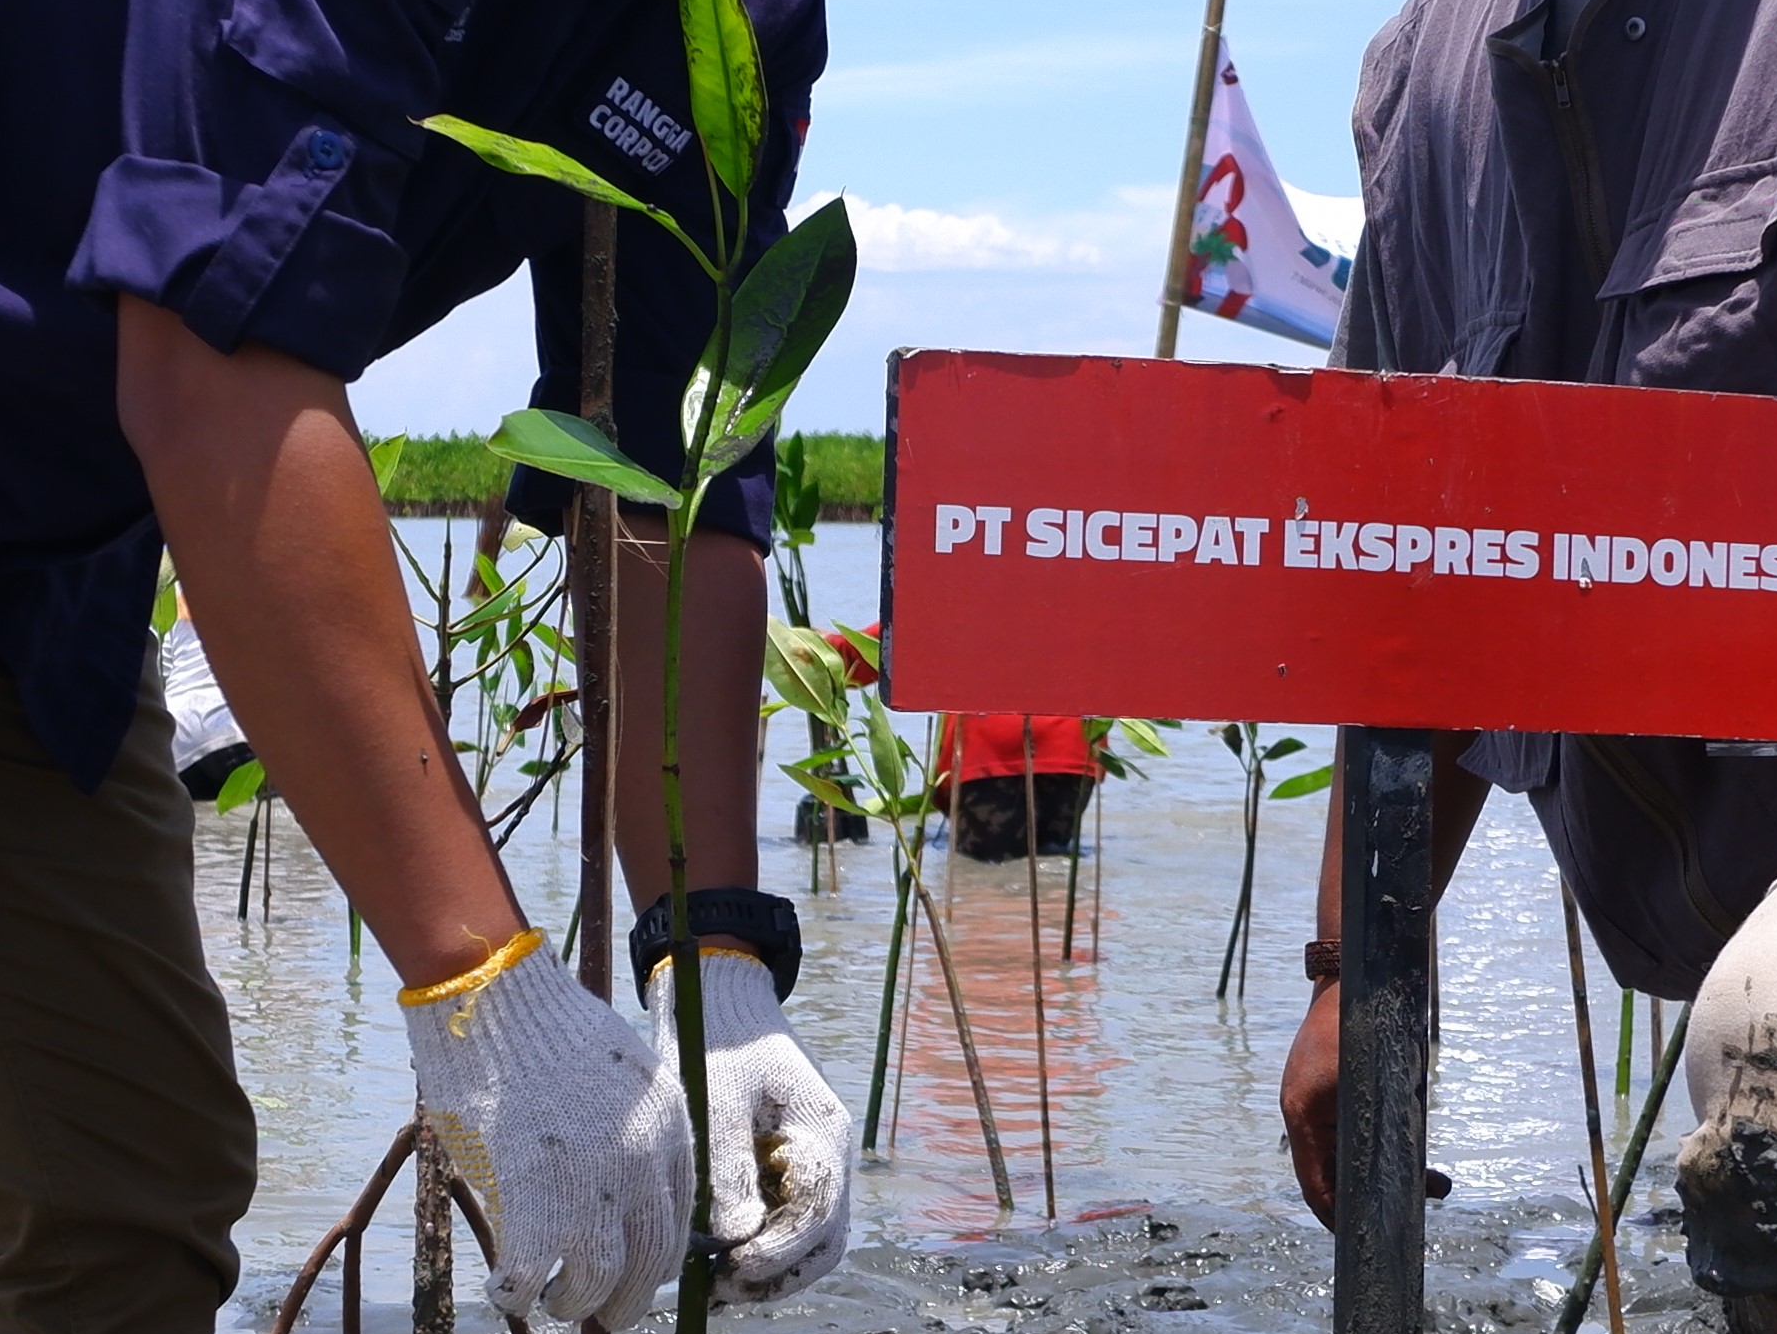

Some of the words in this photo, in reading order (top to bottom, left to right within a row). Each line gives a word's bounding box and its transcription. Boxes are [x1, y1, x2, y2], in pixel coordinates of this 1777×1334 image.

[605, 75, 693, 155] RANGGA
[935, 504, 1012, 555] PT
[1025, 507, 1270, 566] SICEPAT
[1283, 519, 1540, 579] EKSPRES
